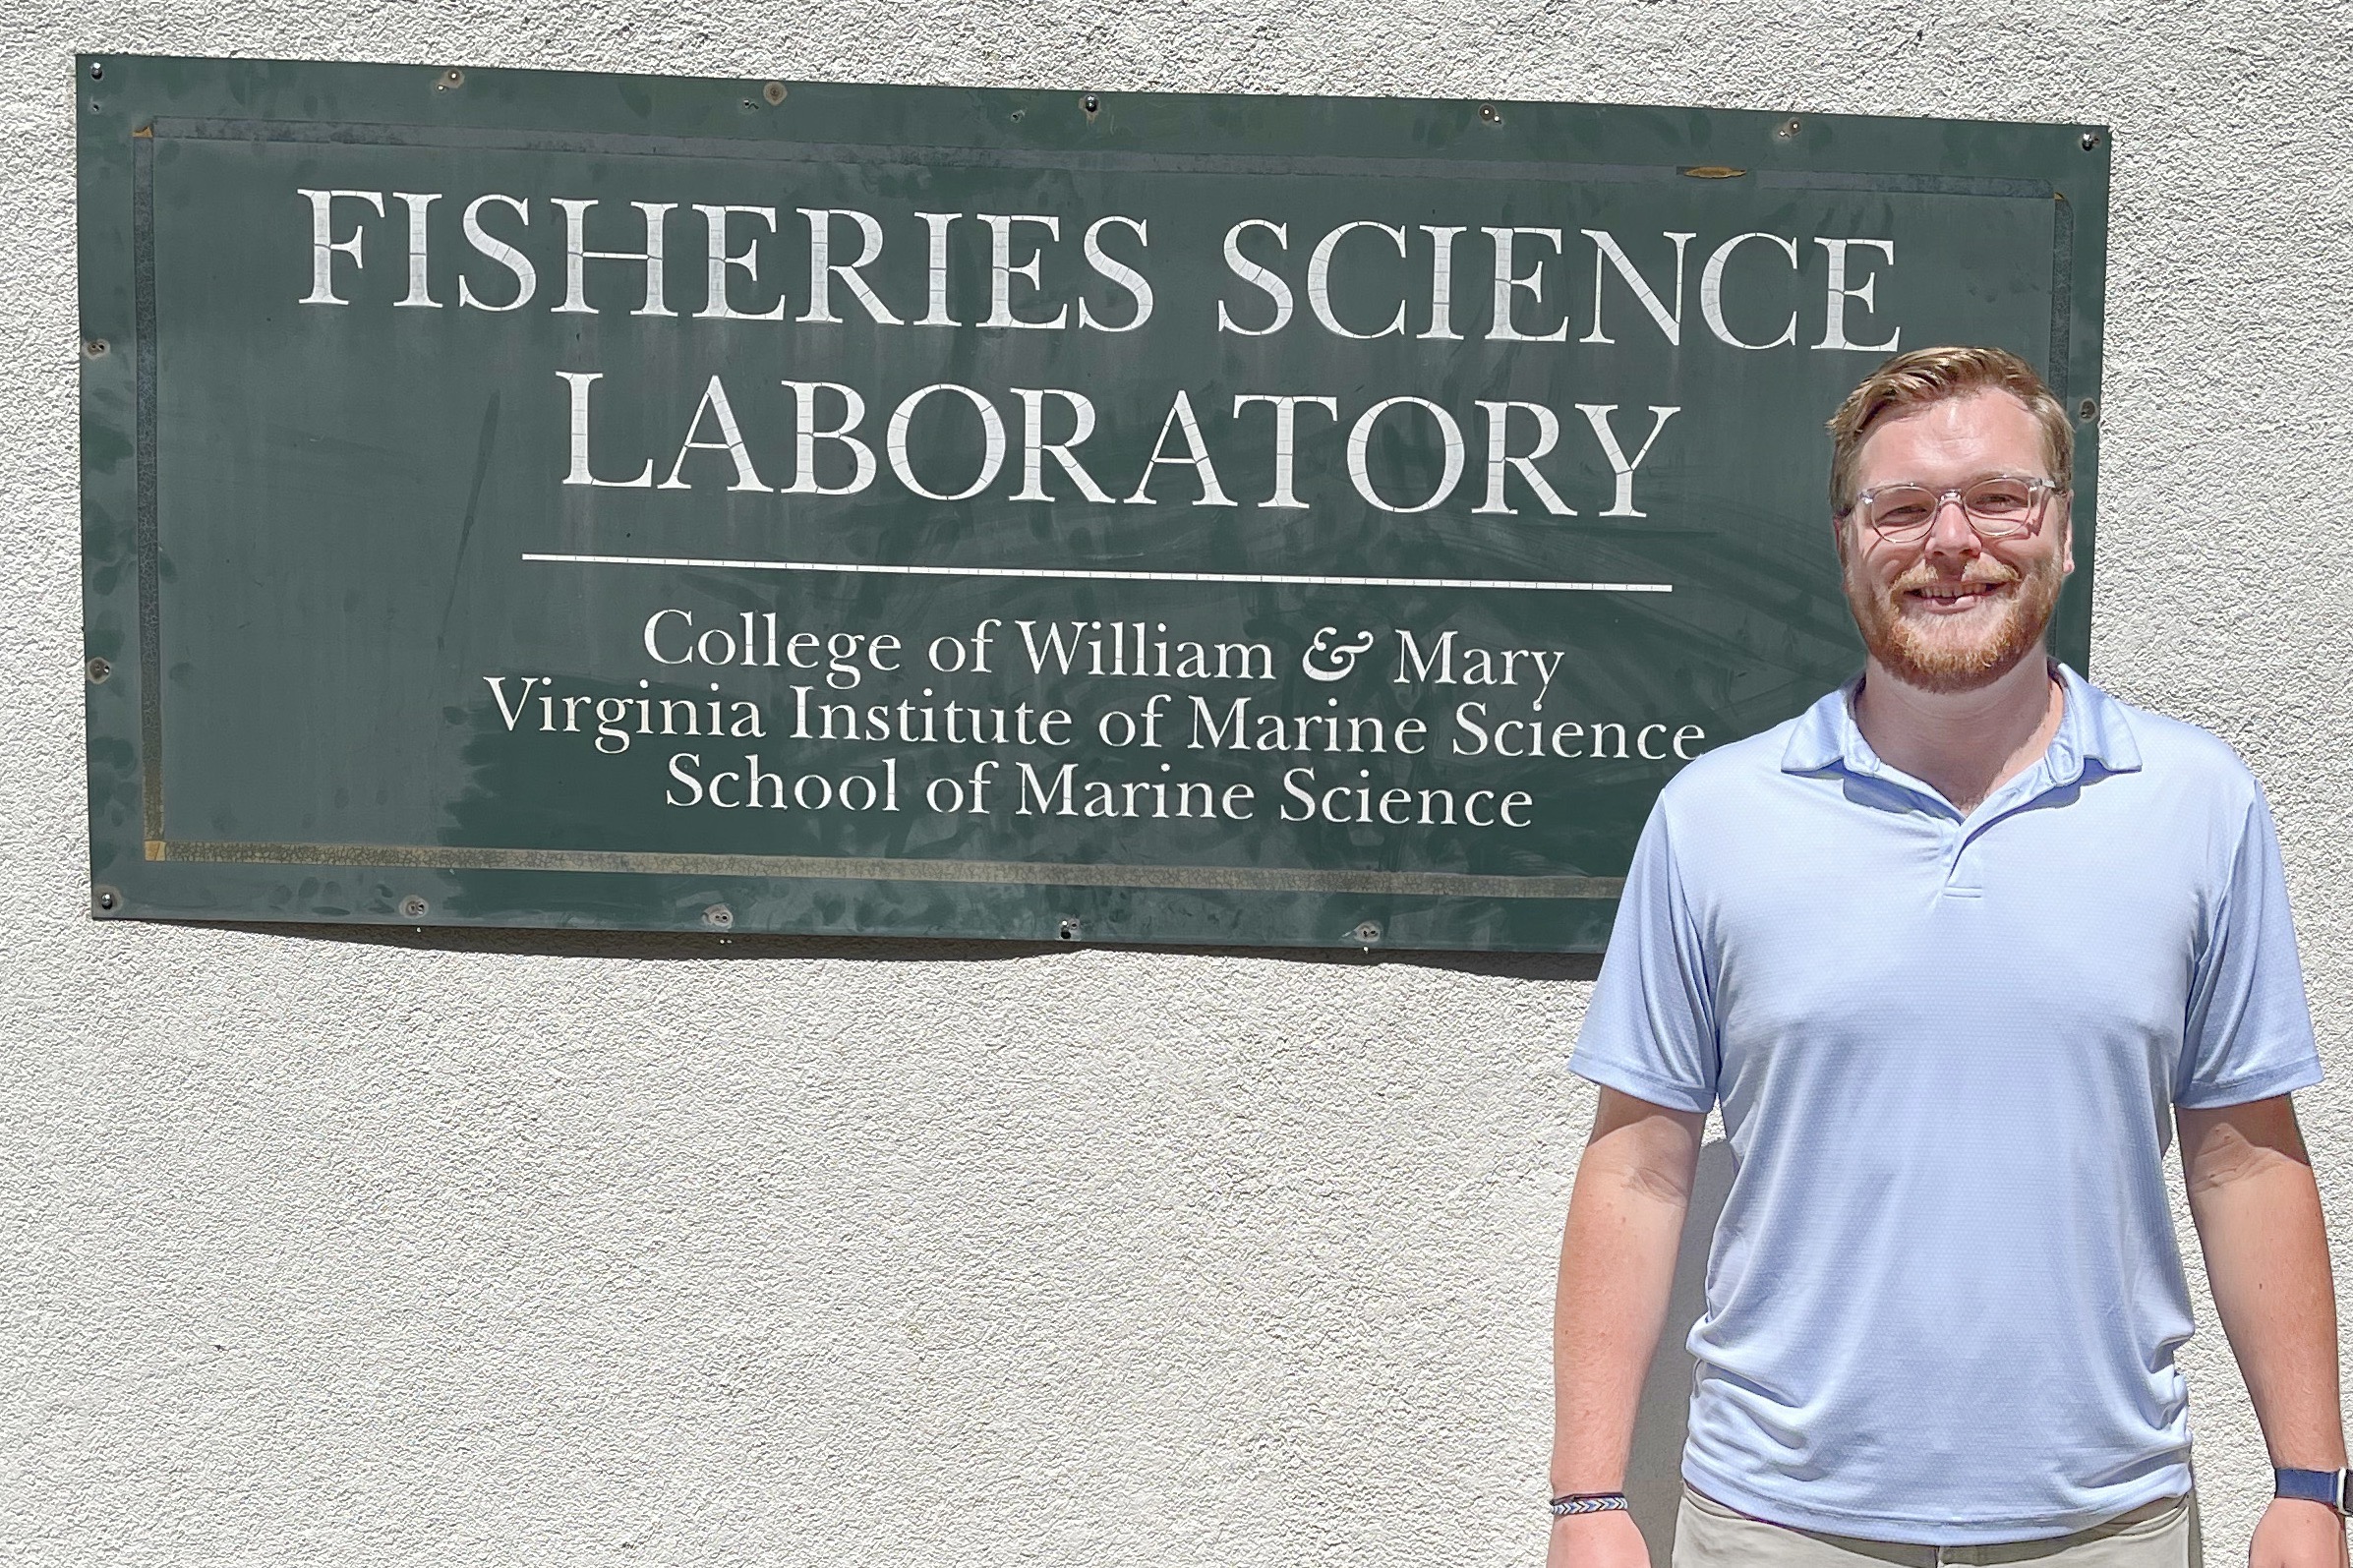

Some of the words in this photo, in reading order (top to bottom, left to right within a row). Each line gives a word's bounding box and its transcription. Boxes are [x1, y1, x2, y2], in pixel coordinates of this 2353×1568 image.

[298, 187, 1155, 333] FISHERIES
[1216, 218, 1903, 355] SCIENCE
[556, 371, 1680, 521] LABORATORY
[643, 608, 902, 690] College
[927, 618, 1002, 674] of
[1014, 619, 1276, 681] William
[1302, 626, 1374, 682] &
[1393, 628, 1566, 713] Mary
[482, 675, 768, 755] Virginia
[788, 684, 1073, 747] Institute
[1097, 693, 1172, 749] of
[1186, 695, 1429, 755] Marine
[1451, 701, 1706, 762] Science
[665, 752, 901, 813] School
[926, 760, 1001, 815] of
[1014, 761, 1256, 821] Marine
[1279, 767, 1534, 830] Science
